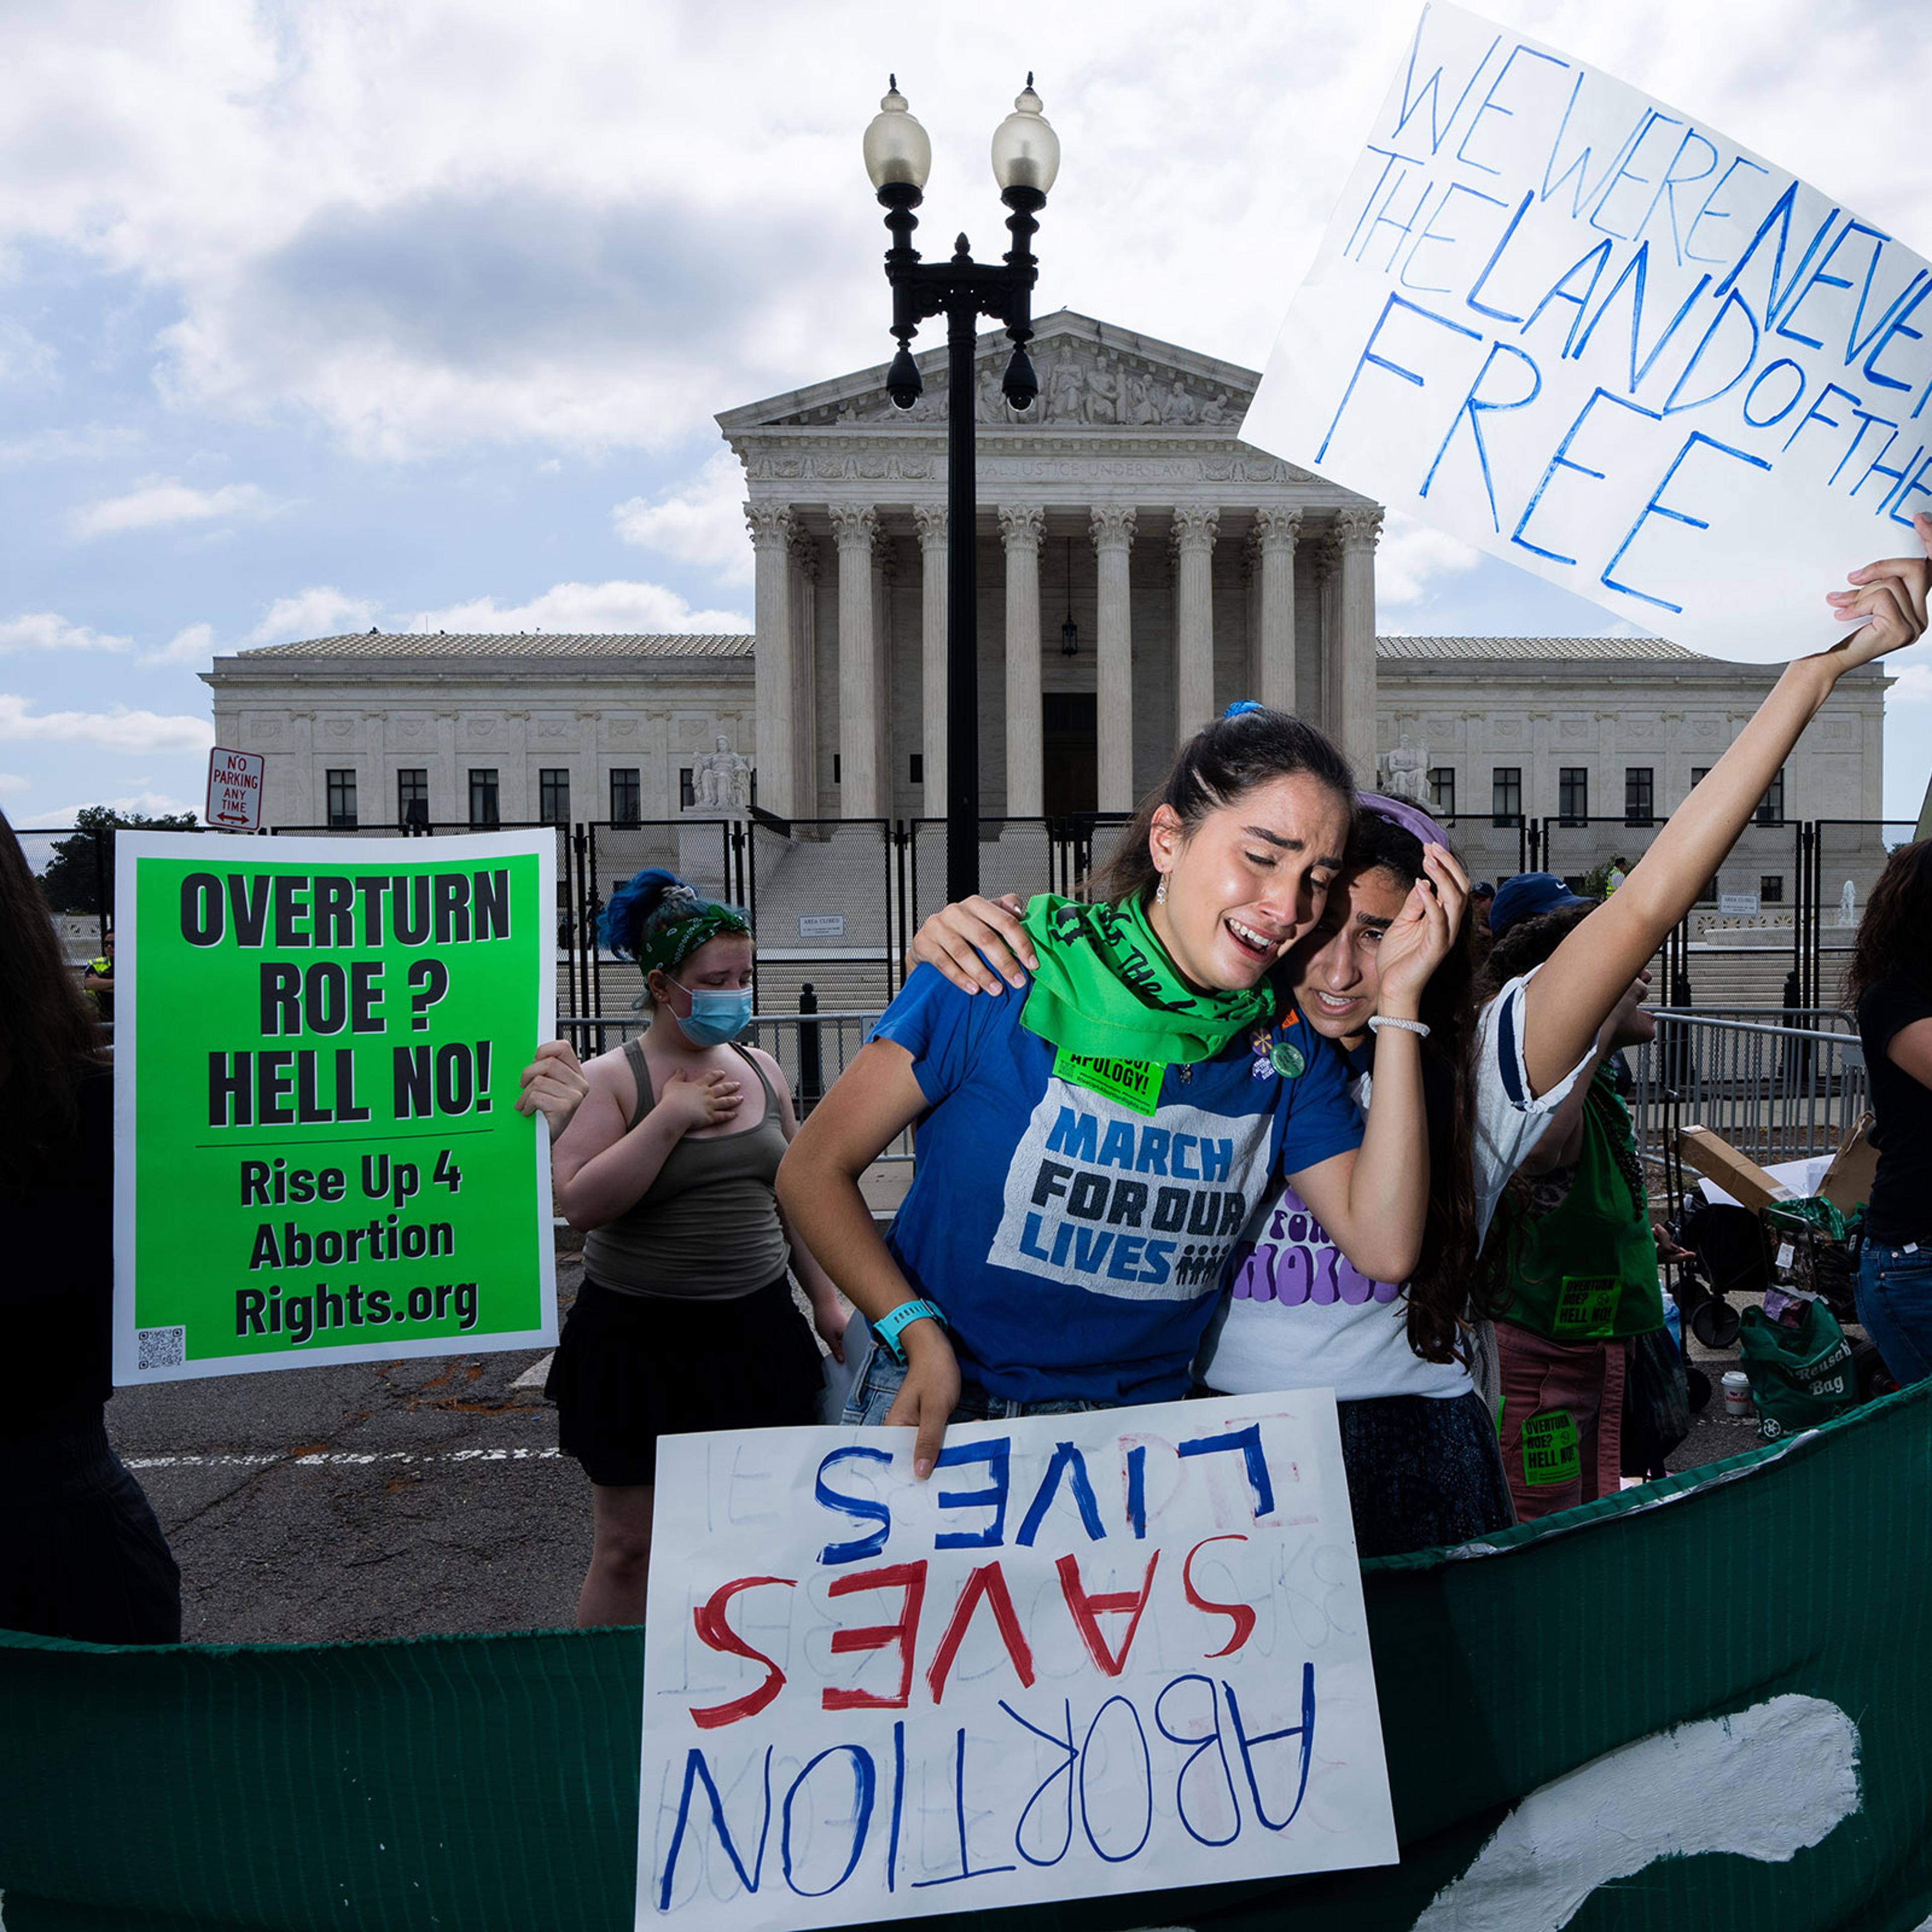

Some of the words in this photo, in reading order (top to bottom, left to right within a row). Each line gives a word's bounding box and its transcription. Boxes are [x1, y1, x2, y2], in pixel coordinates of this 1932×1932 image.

[1391, 2, 1571, 176] WE
[1540, 70, 1770, 267] WERE
[1712, 179, 1932, 419] NEVE
[1343, 144, 1509, 294] THE
[1465, 190, 1761, 417] LAND
[1742, 357, 1863, 452] OF
[1313, 290, 1774, 615] FREE
[214, 769, 258, 789] PARKING
[224, 788, 247, 800] ANY
[228, 756, 247, 771] NO
[222, 799, 247, 813] TIME
[180, 869, 510, 947] OVERTURN
[260, 961, 386, 1035] ROE
[208, 1049, 370, 1126] HELL
[393, 1040, 492, 1119] NO!
[241, 1158, 346, 1207] Rise
[362, 1154, 419, 1209] Up
[433, 1149, 462, 1193] 4
[1045, 1105, 1233, 1182] MARCH
[1031, 1158, 1149, 1228] FOR
[1151, 1186, 1246, 1236] OUR
[249, 1214, 454, 1270] Abortion
[1019, 1211, 1178, 1285] LIVES
[235, 1282, 478, 1344] Rights.org
[1810, 1376, 1844, 1395] Bag
[815, 1423, 1274, 1565] LIVES
[1528, 1450, 1558, 1469] HELL
[689, 1535, 1256, 1729] SAVES
[660, 1662, 1316, 1910] ABORTION
